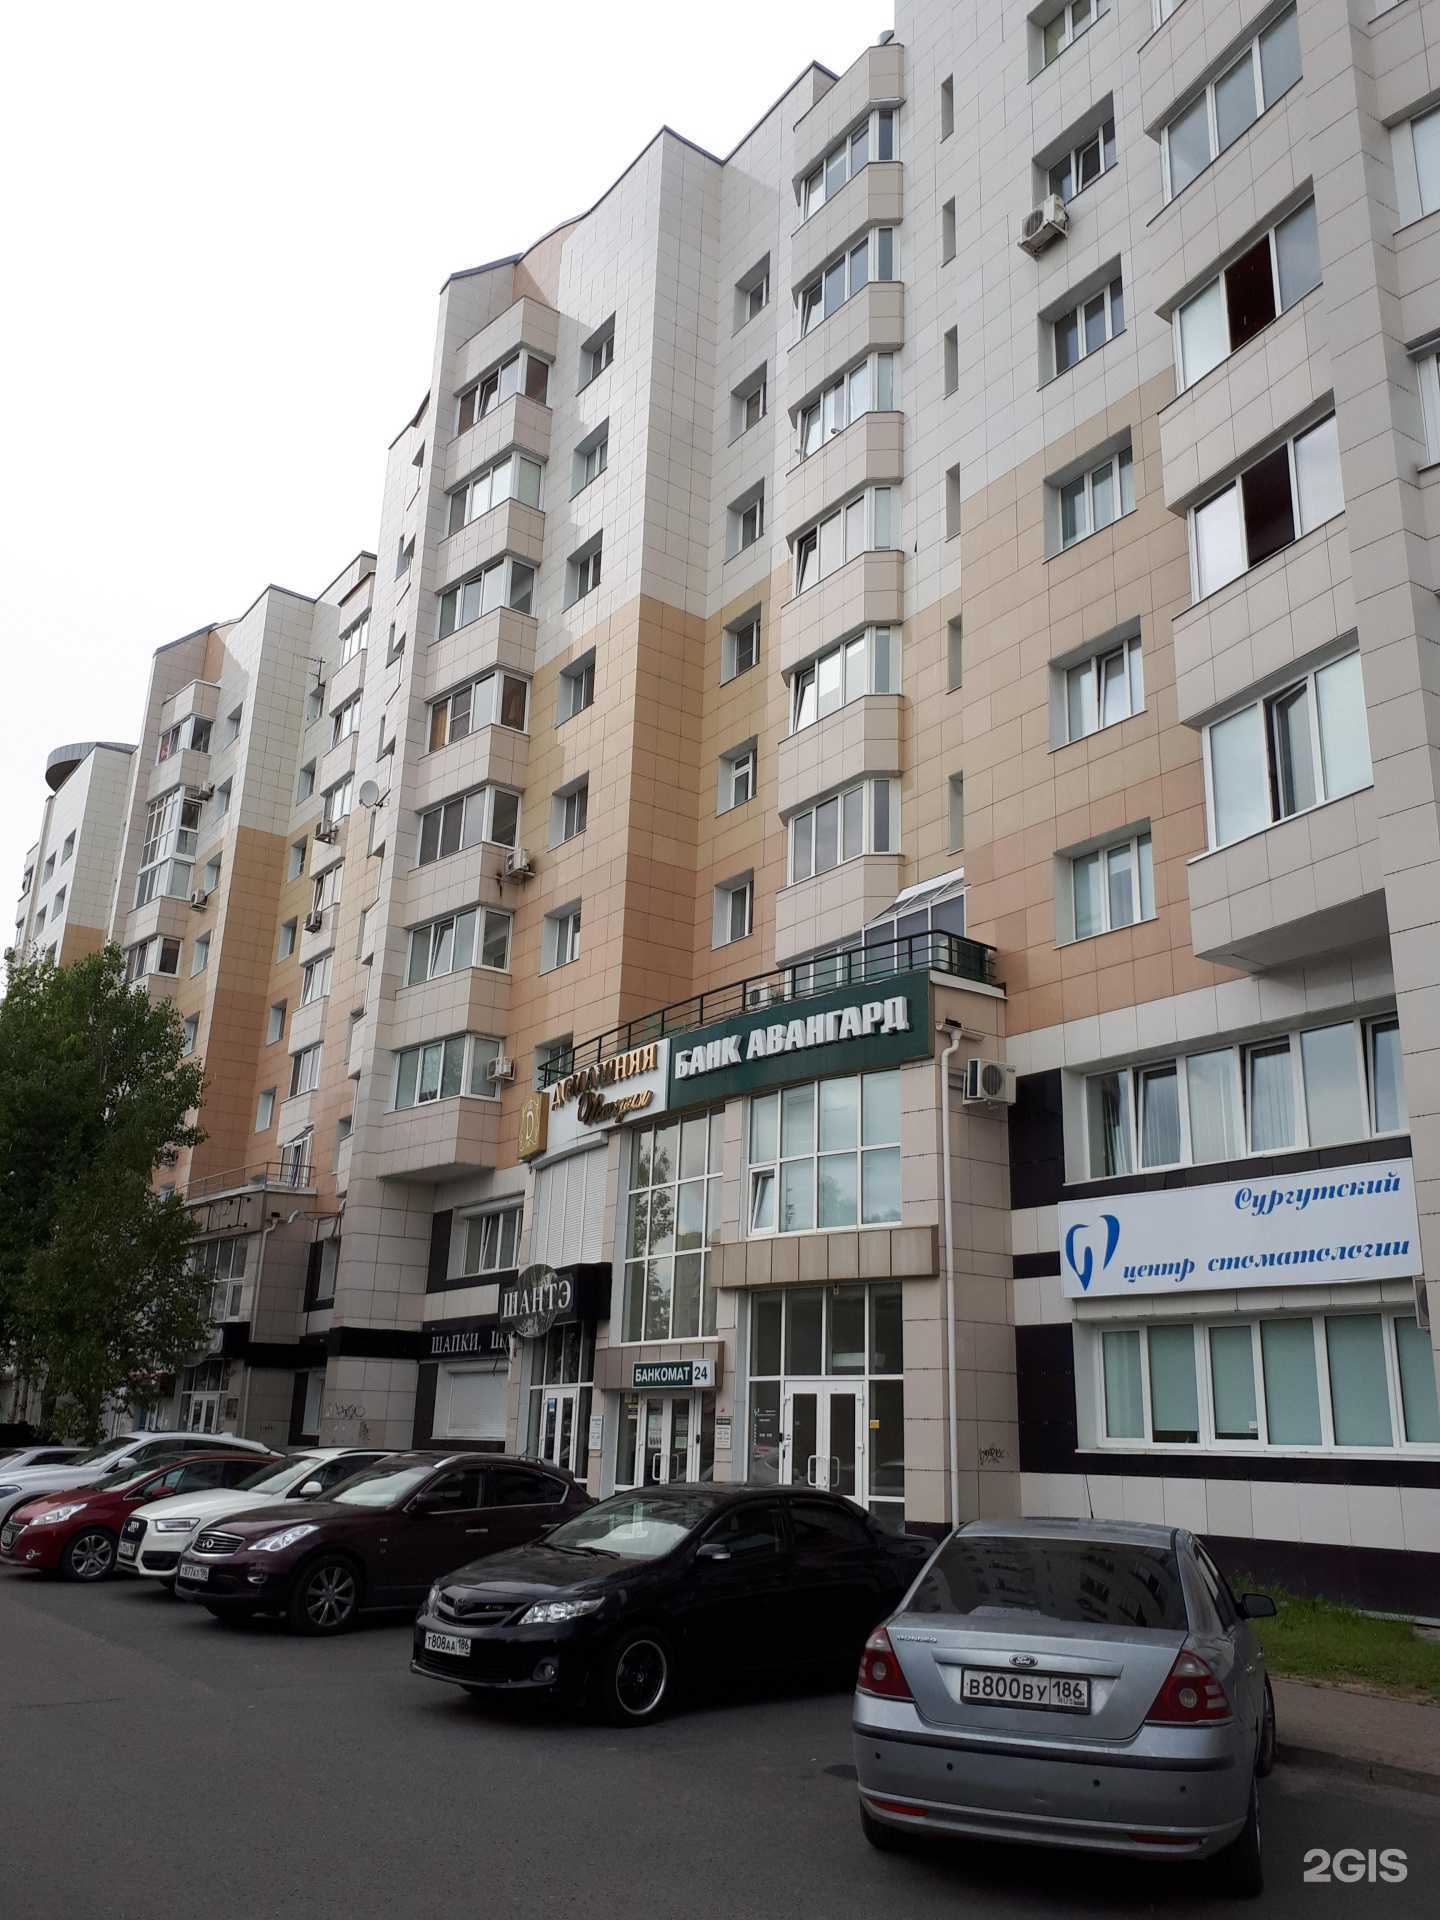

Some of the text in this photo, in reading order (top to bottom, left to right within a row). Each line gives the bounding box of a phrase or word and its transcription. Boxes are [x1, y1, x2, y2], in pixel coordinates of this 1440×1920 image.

[675, 996, 911, 1080] БАНК АВАНГАРД
[1235, 1171, 1401, 1216] Сургутский
[1123, 1240, 1410, 1282] центр стоматологии
[503, 1280, 571, 1318] ШАНТЭ
[431, 1332, 482, 1354] ШАПКИ,
[635, 1366, 708, 1382] БАНКОМАТ 24
[1052, 1680, 1082, 1699] 186
